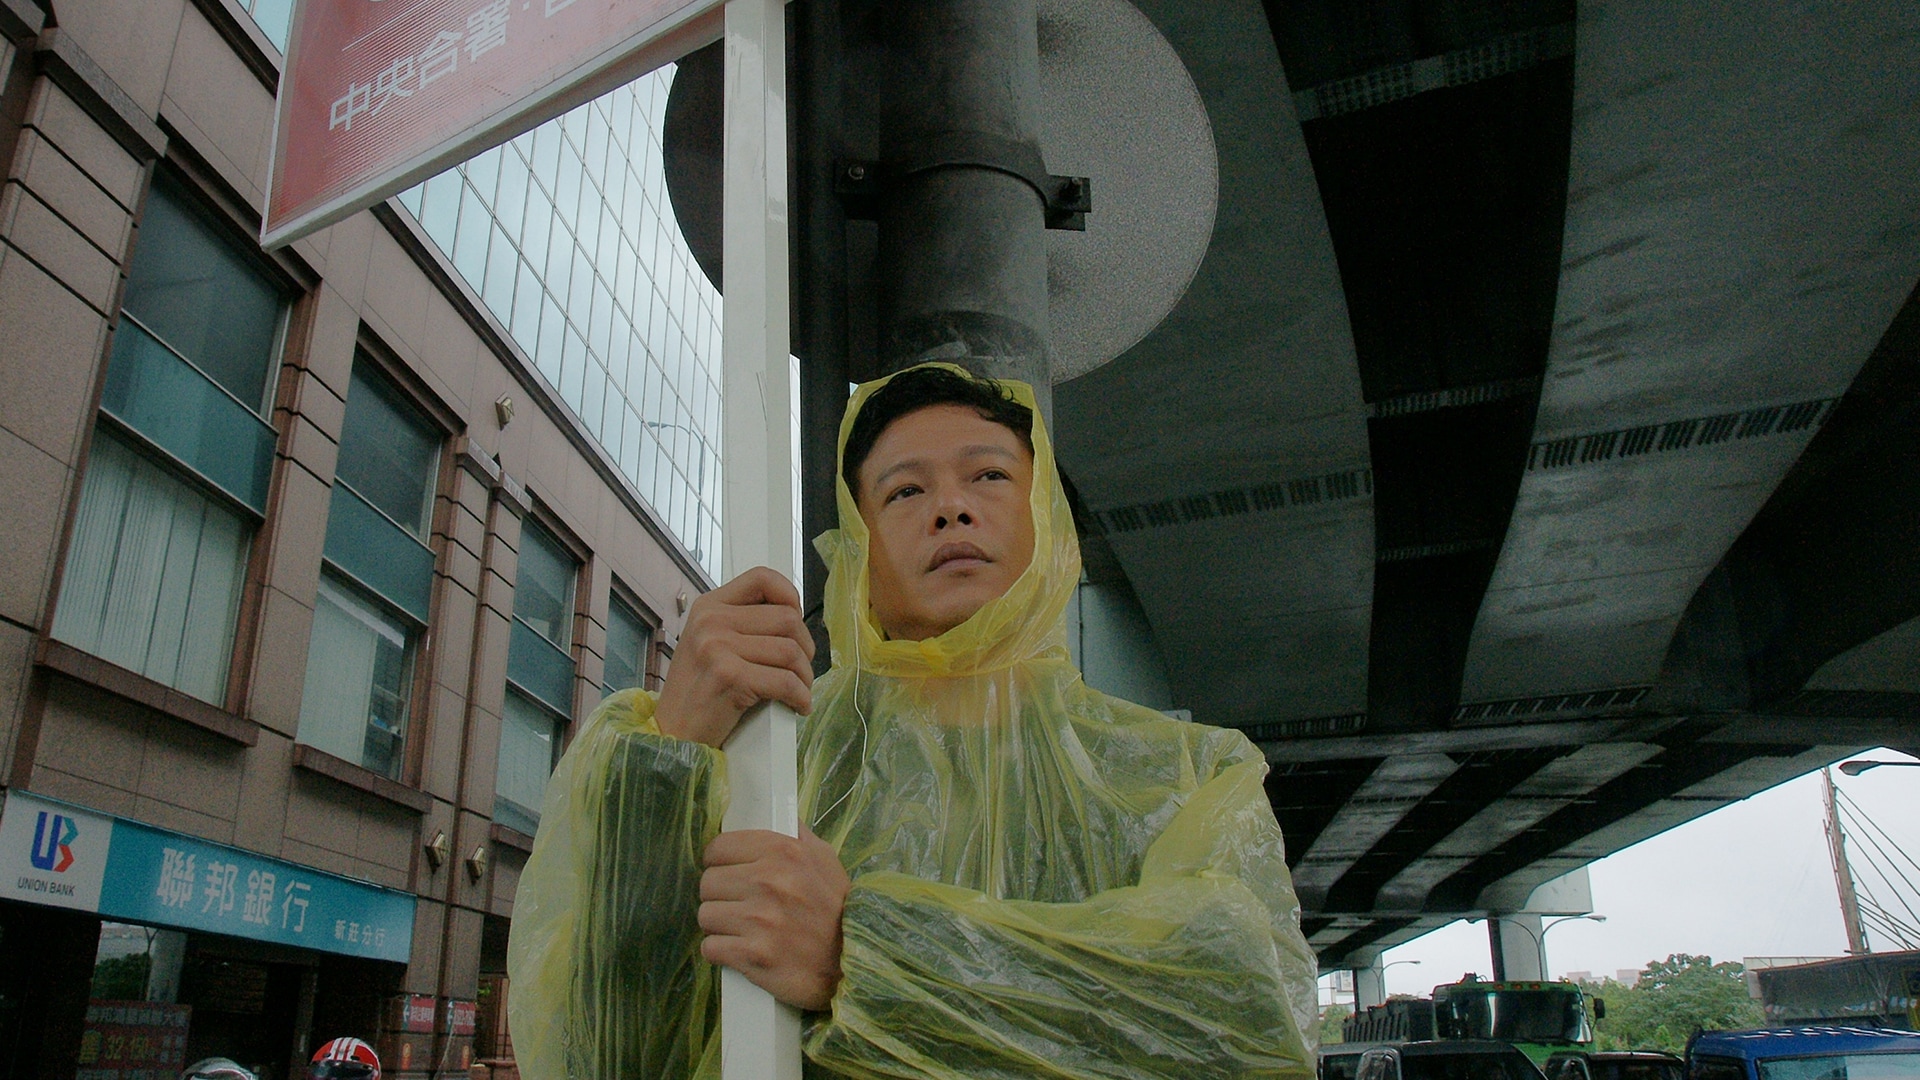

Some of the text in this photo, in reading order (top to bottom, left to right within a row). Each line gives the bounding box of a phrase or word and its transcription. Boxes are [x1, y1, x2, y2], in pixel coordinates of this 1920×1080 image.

[17, 876, 76, 896] UNION BANK
[157, 847, 312, 932] 聯邦銀行
